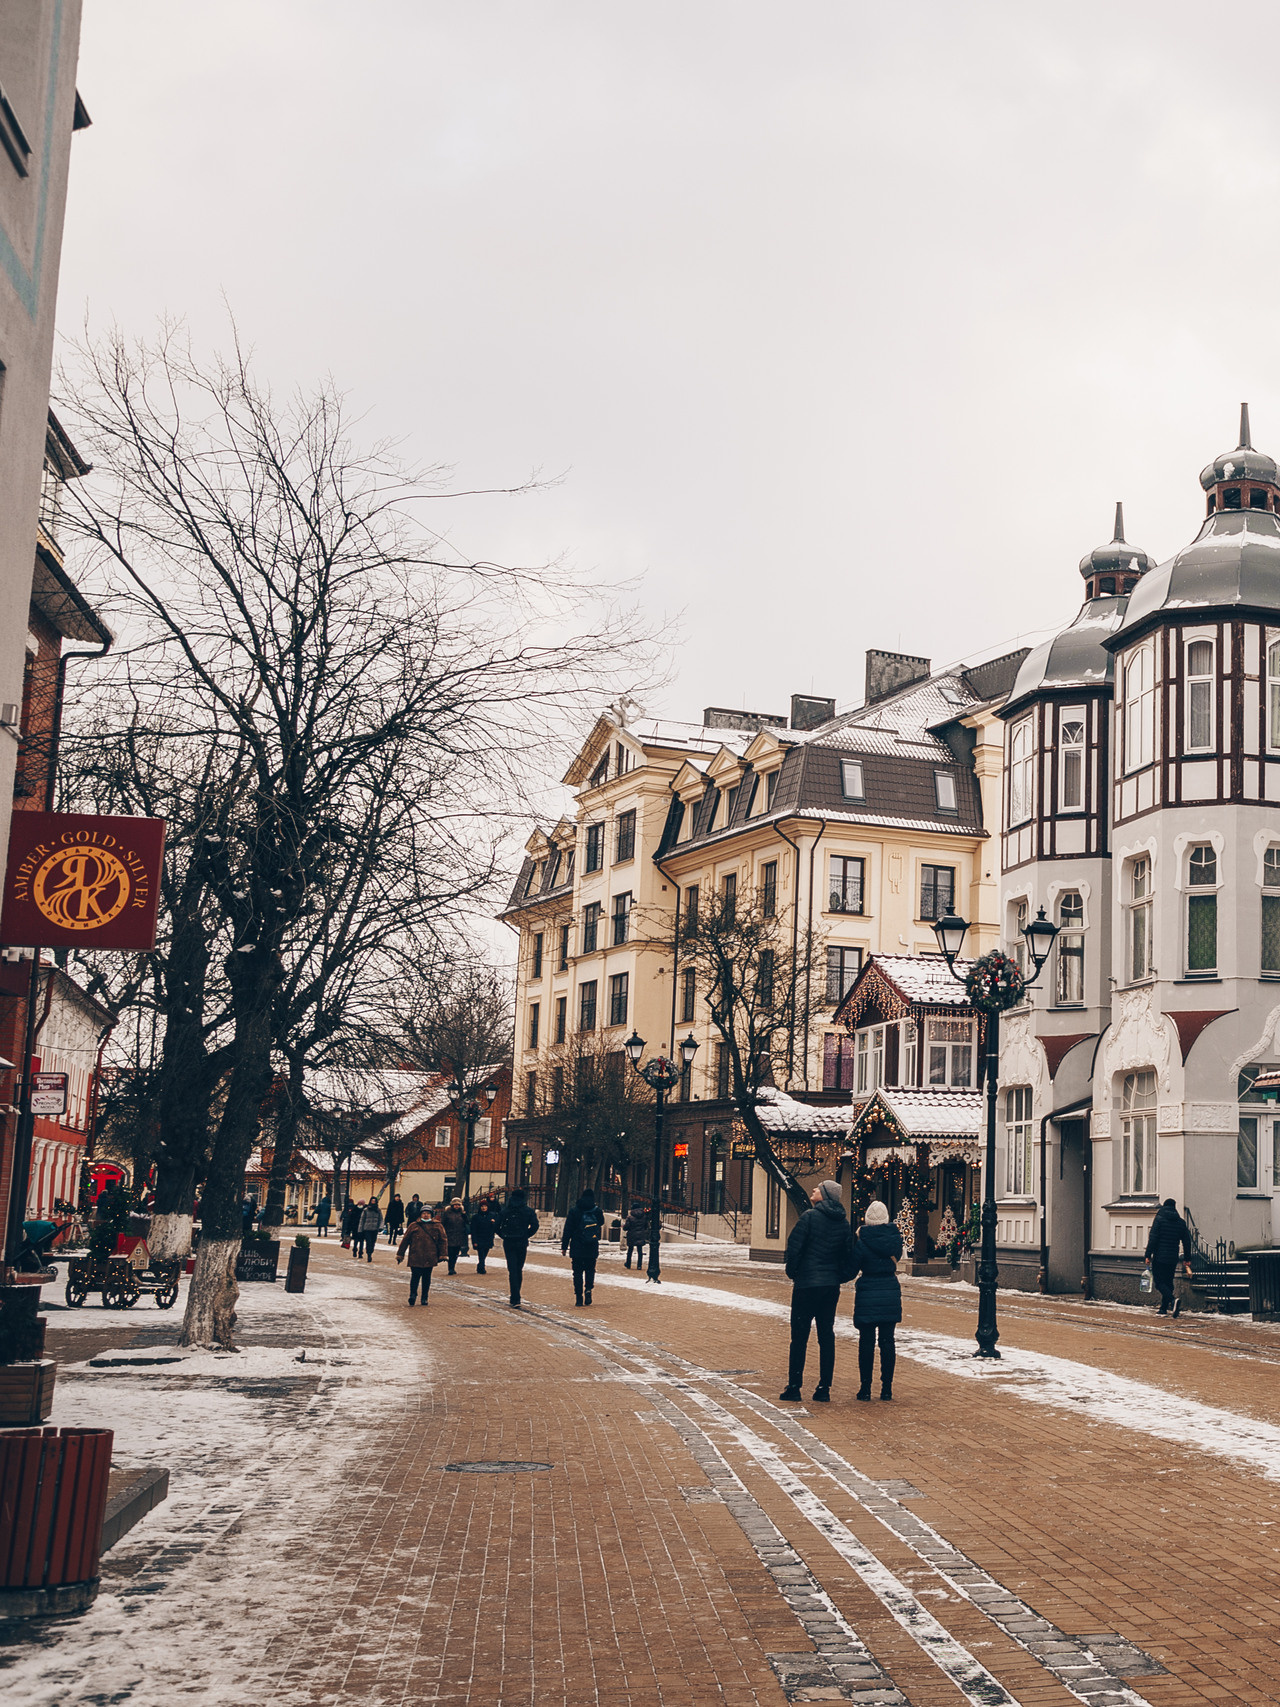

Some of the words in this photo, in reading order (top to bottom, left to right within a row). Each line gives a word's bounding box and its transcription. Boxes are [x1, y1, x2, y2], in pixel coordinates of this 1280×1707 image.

[14, 844, 50, 902] AMBER
[61, 830, 116, 848] GOLD
[123, 850, 149, 909] SILVER
[42, 848, 125, 876] ЯНТАРНЫЙ
[40, 901, 122, 928] КОМБИНАТ
